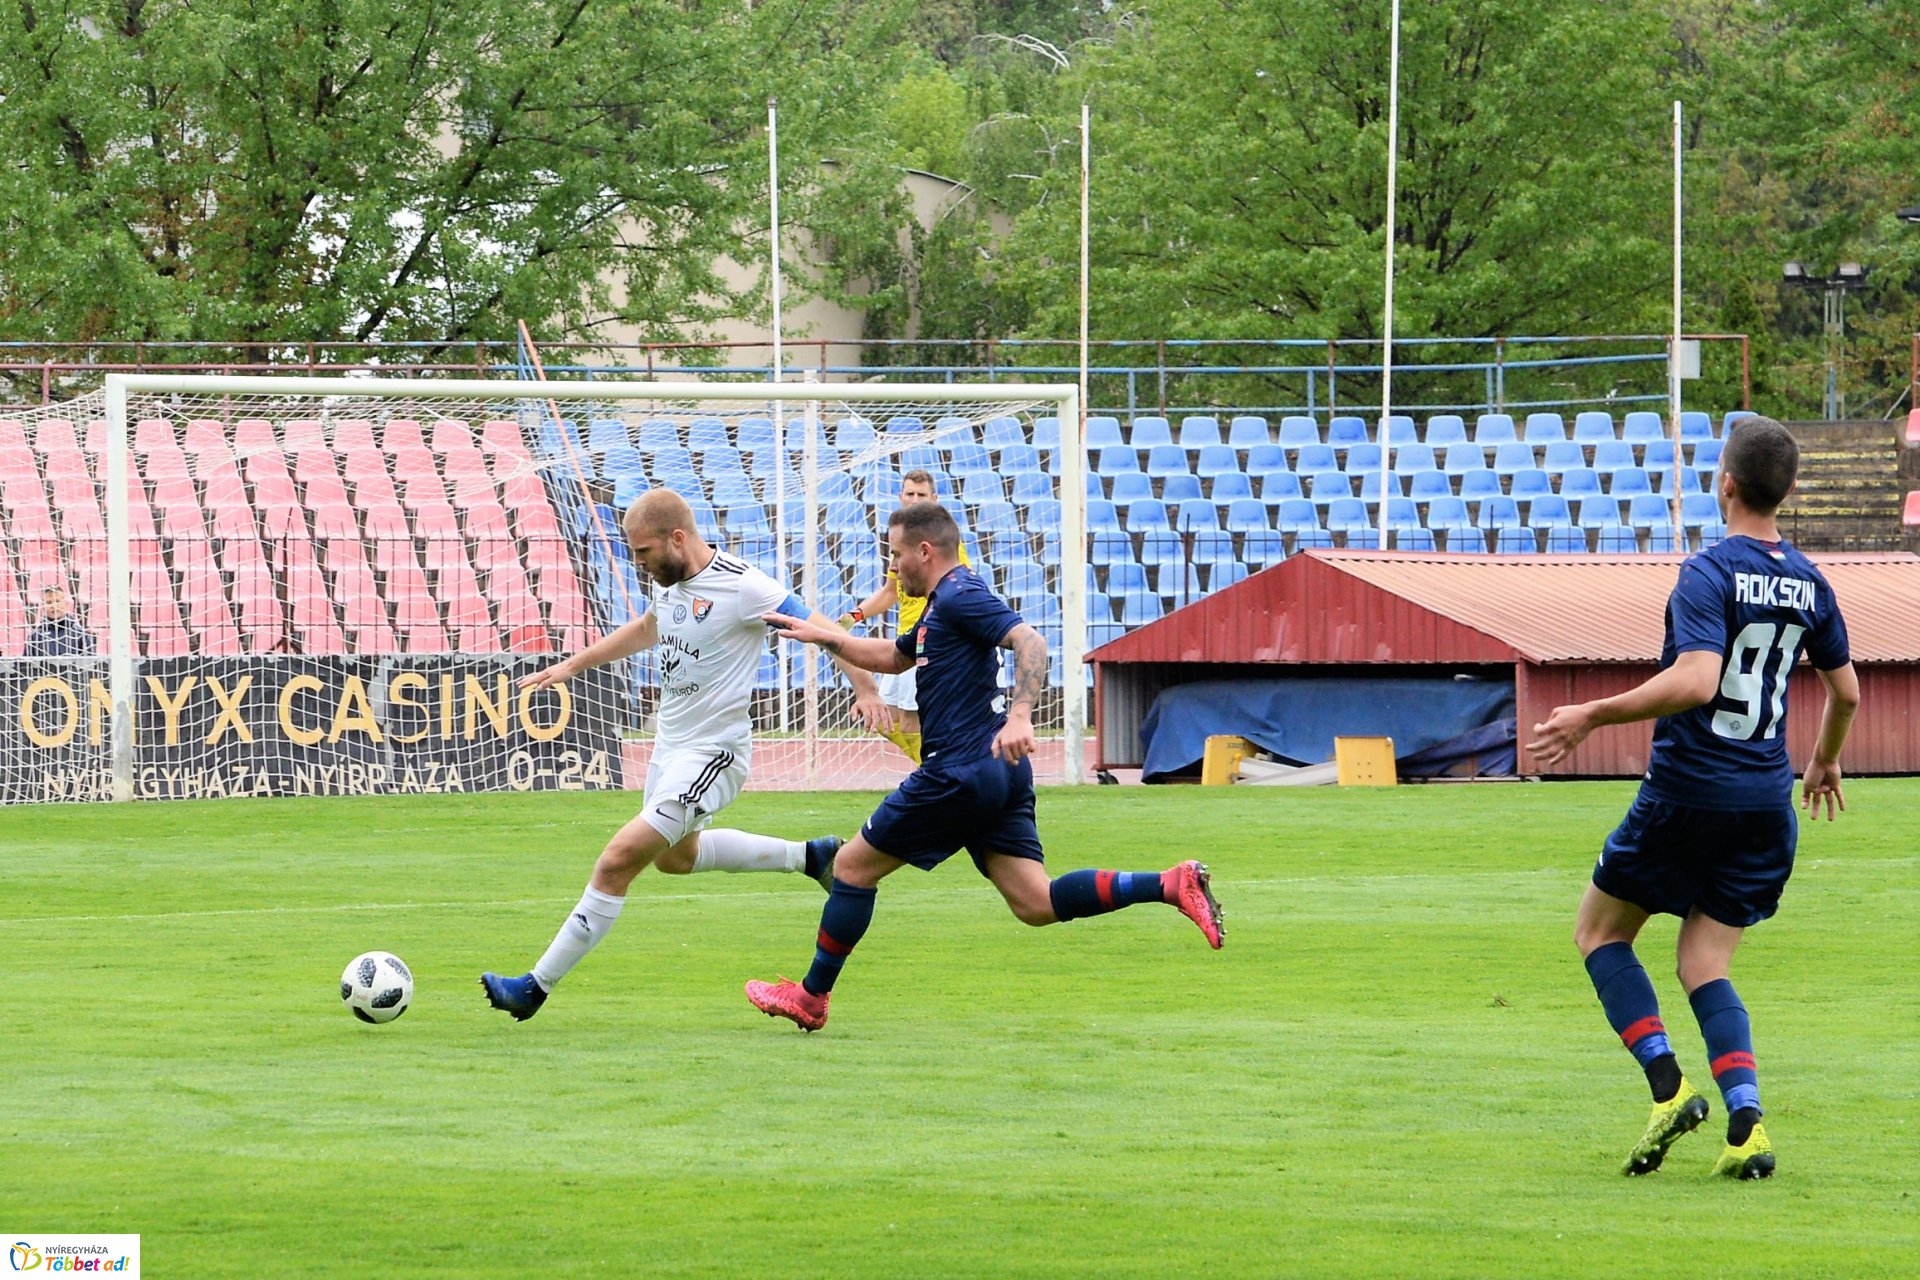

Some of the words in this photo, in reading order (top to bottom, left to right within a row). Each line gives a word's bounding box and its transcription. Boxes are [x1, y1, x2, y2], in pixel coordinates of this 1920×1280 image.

[1734, 572, 1816, 612] ROKSZIN
[279, 672, 572, 745] CASINO
[1711, 622, 1807, 741] 91
[508, 750, 610, 792] 0-24
